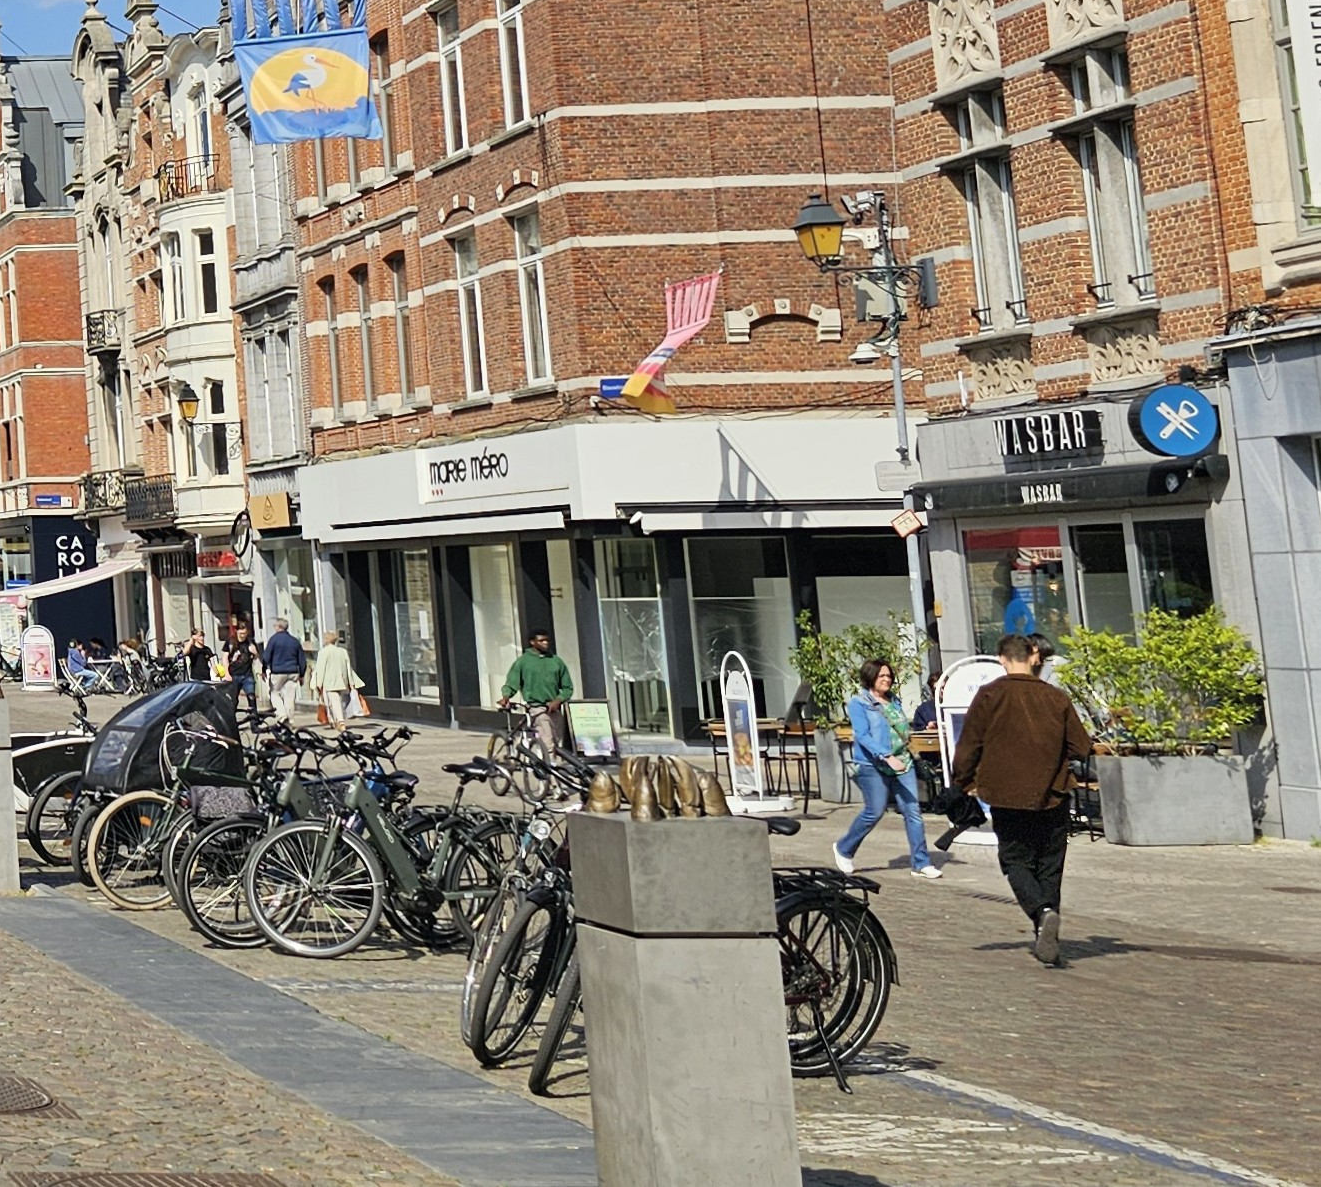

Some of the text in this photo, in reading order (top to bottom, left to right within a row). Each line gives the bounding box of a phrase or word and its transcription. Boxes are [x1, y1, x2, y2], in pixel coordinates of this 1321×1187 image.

[992, 410, 1087, 456] WASBAR
[1020, 483, 1063, 504] WASBAR
[55, 535, 83, 550] CA
[57, 551, 85, 566] RO
